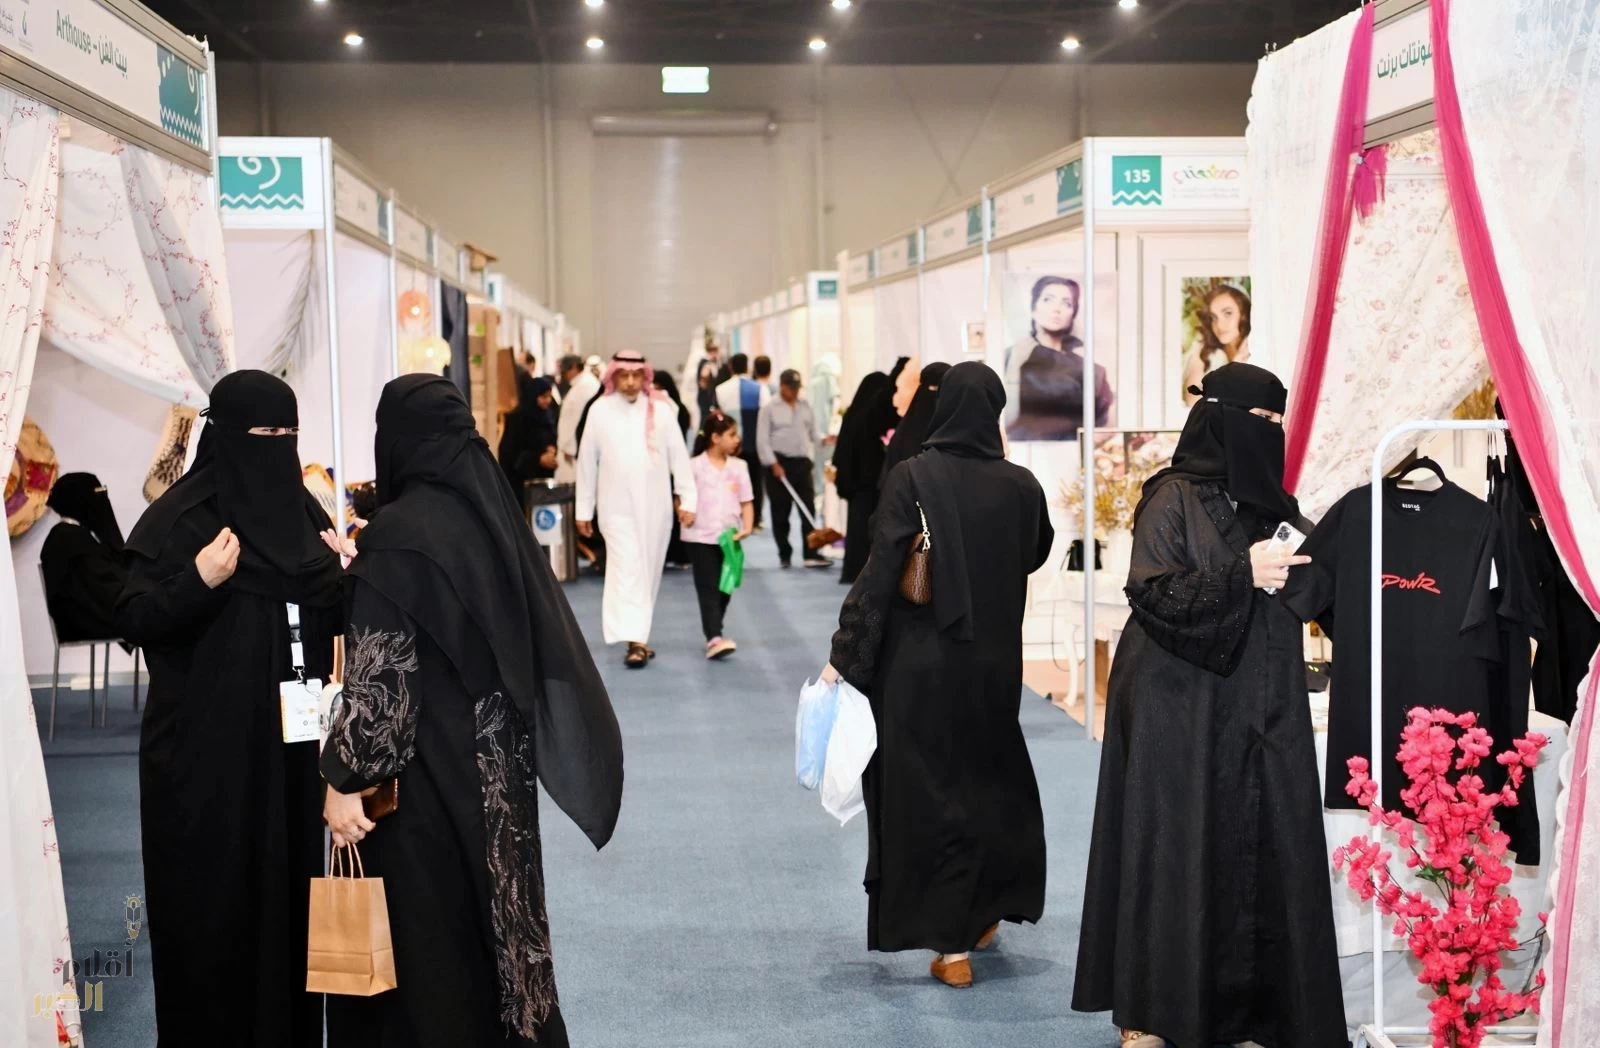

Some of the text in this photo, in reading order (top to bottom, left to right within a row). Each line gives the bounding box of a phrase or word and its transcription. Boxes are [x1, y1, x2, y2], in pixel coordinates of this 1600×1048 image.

[56, 9, 92, 55] Arthouse
[98, 34, 114, 65] الفن
[114, 47, 128, 79] بيت
[1377, 53, 1398, 78] برنت
[1124, 169, 1151, 184] 135
